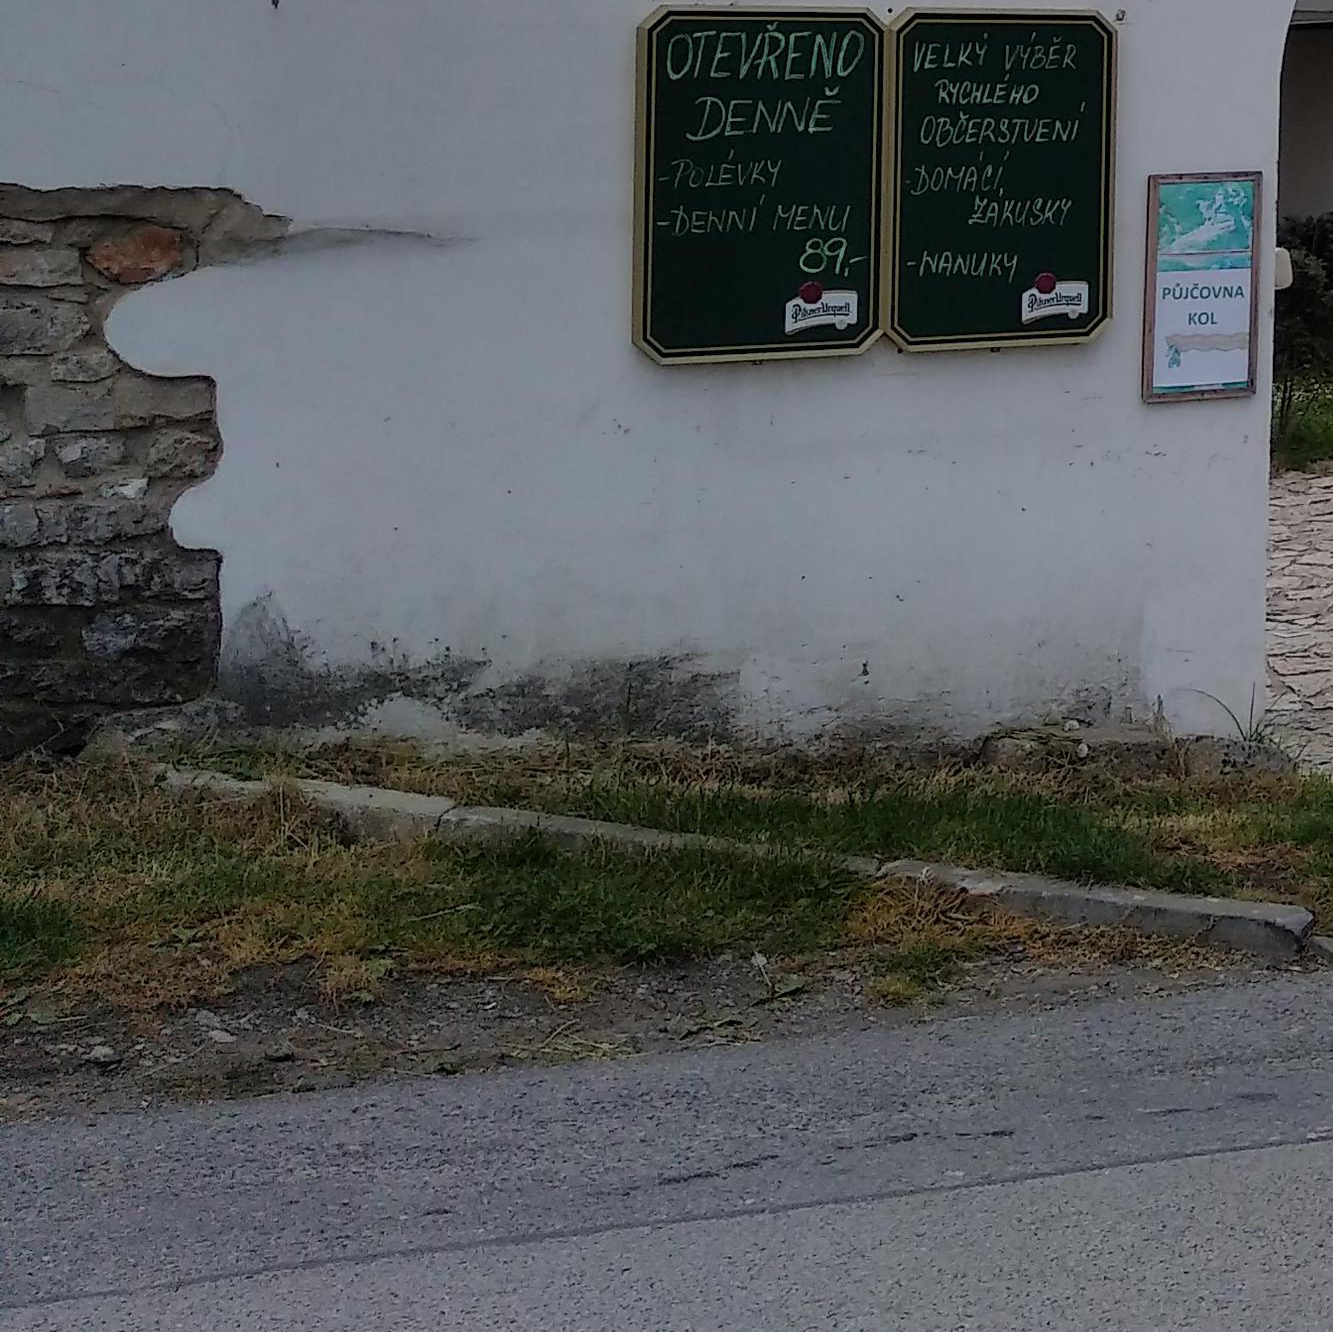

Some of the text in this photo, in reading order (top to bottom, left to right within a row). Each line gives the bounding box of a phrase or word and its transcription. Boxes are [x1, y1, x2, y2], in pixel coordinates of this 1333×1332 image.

[666, 22, 865, 81] OTEVŘENO
[912, 32, 1078, 73] VELKÝ VÝBĚR
[934, 73, 1039, 106] RYCHLÉHO
[686, 85, 842, 142] DENNĚ
[919, 101, 1087, 147] OBČERSTVENÍ
[772, 204, 852, 234] MENU
[1162, 282, 1245, 301] PŮJČOVNA
[1188, 312, 1218, 326] KOL
